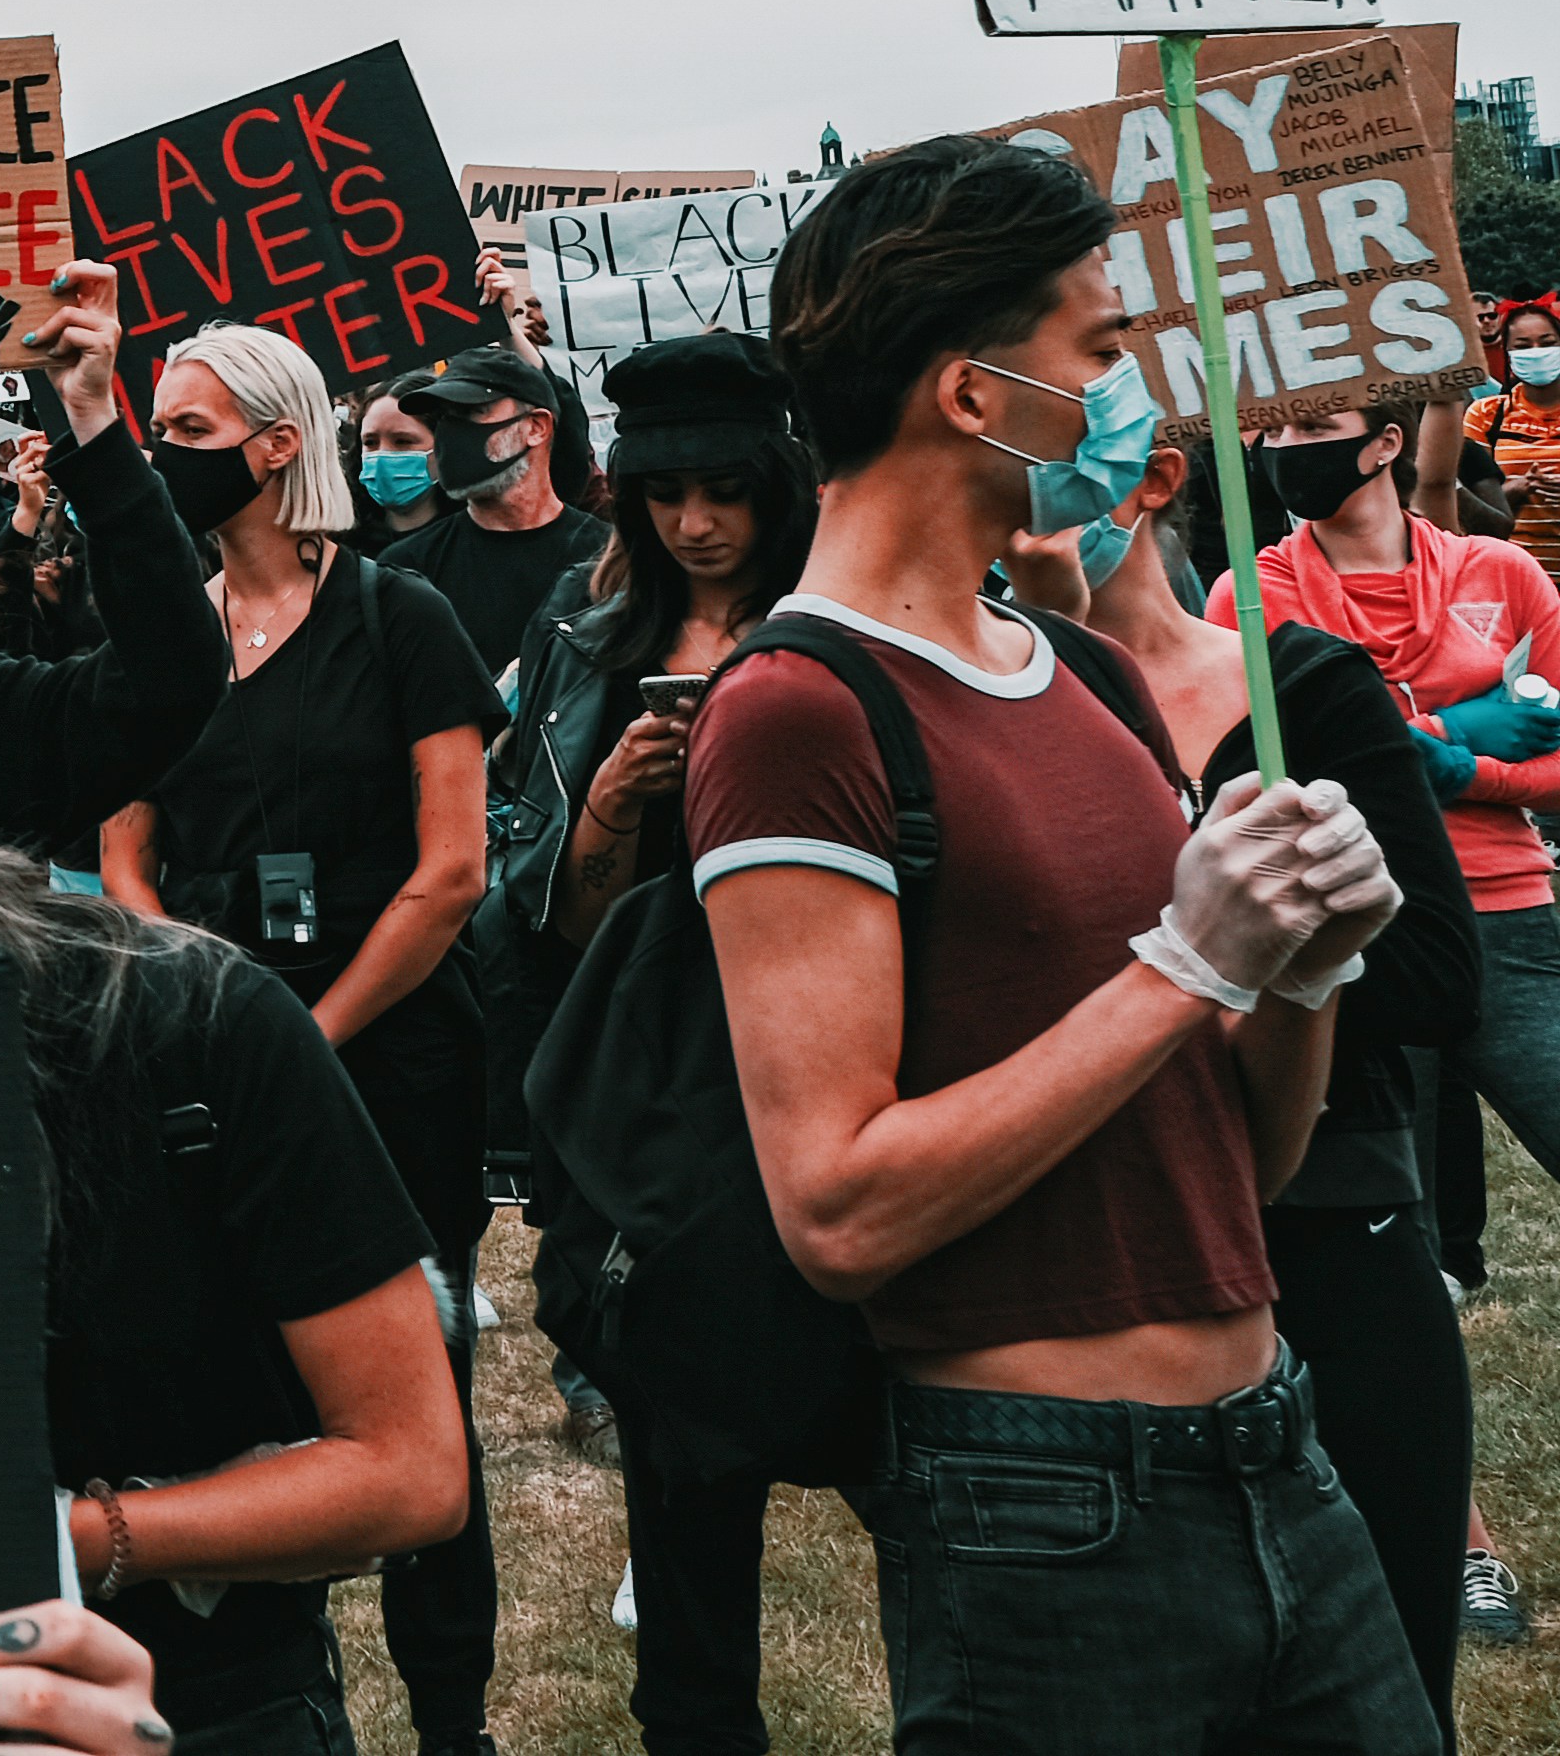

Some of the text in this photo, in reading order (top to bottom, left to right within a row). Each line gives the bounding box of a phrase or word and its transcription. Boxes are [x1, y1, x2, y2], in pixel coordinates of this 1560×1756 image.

[1292, 51, 1364, 87] BELLY
[1287, 69, 1398, 110] MUJINGA
[1278, 108, 1349, 138] JACOB
[1300, 116, 1413, 158] MICHAEL
[74, 79, 373, 245] LACK
[1277, 144, 1425, 187] DEREK BENNETT
[469, 182, 607, 222] WHITE
[1120, 199, 1177, 223] HEKU
[104, 164, 405, 336] IVES
[1102, 178, 1438, 318] HEIR
[1281, 260, 1441, 297] LEON BRIGGS
[559, 262, 776, 352] LIVE
[1366, 366, 1486, 404] SARAH REED
[1237, 393, 1350, 431] SEAN RIGG
